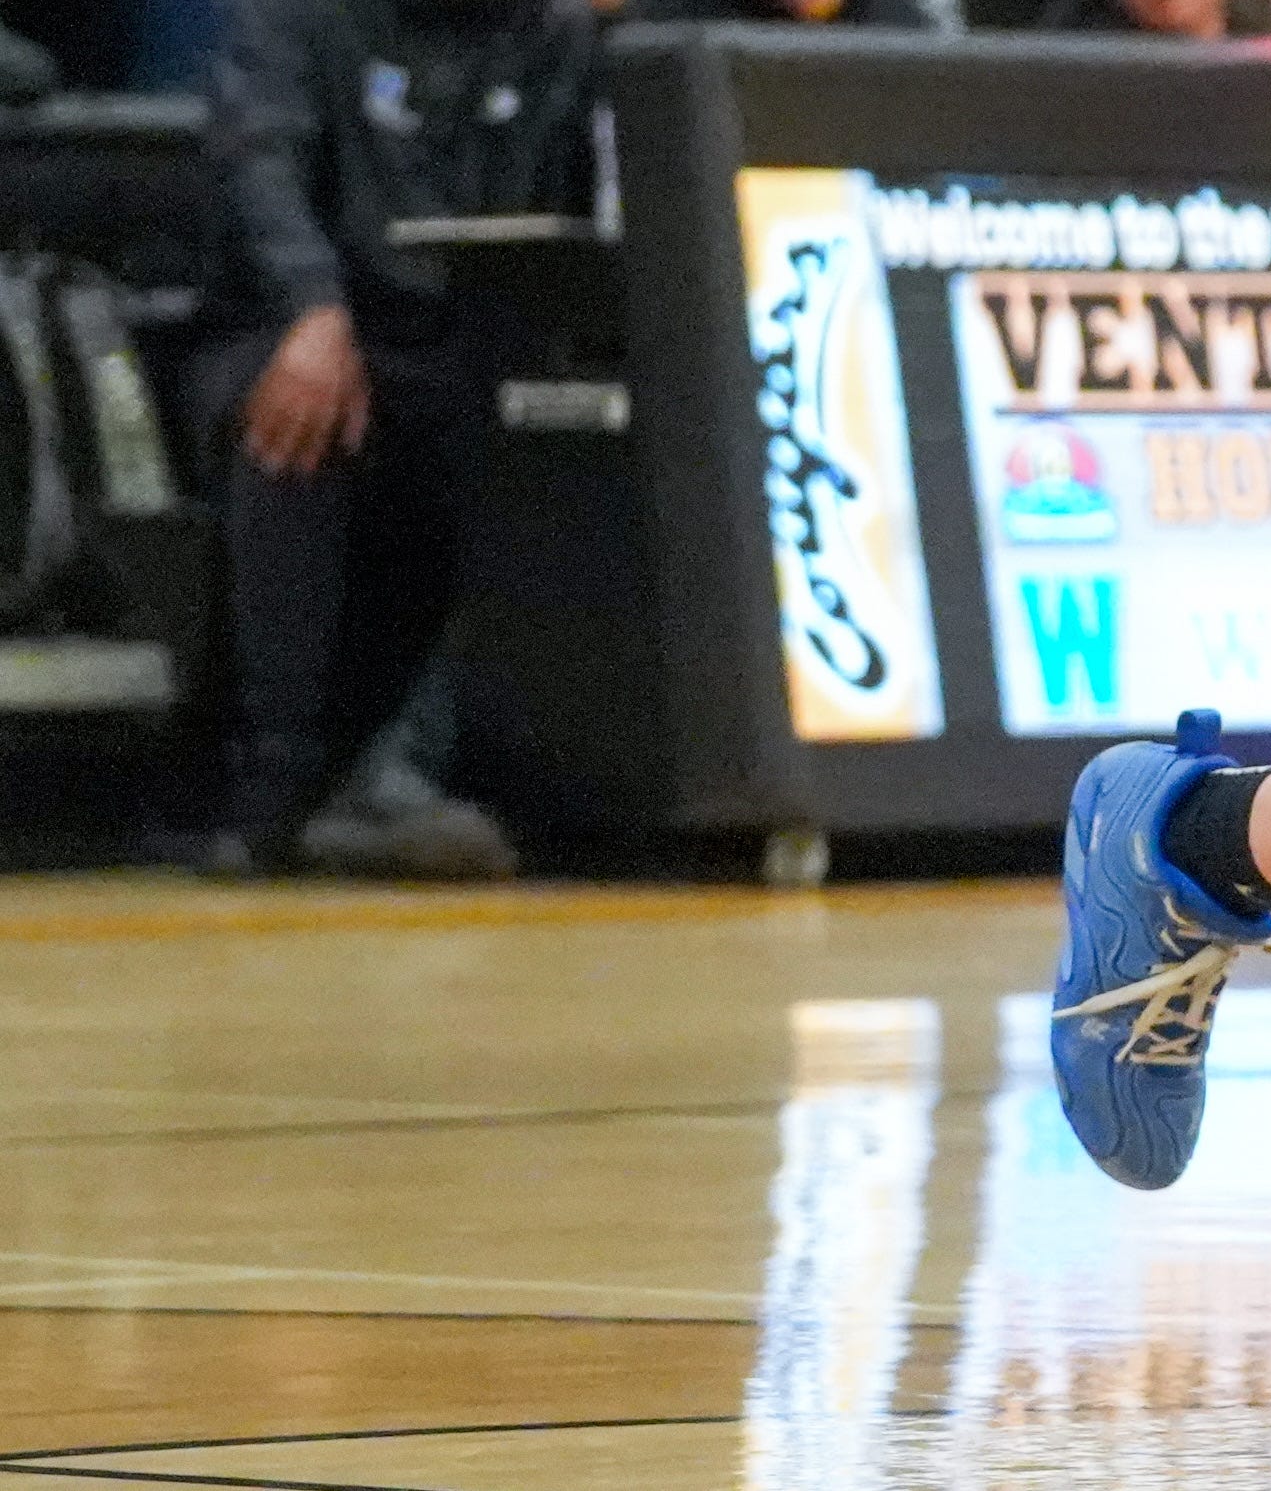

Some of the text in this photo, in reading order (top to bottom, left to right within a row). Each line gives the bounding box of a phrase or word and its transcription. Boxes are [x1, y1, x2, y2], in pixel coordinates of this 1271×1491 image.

[878, 185, 1116, 270] Welcome
[1115, 193, 1180, 271] to
[1018, 573, 1122, 715] W
